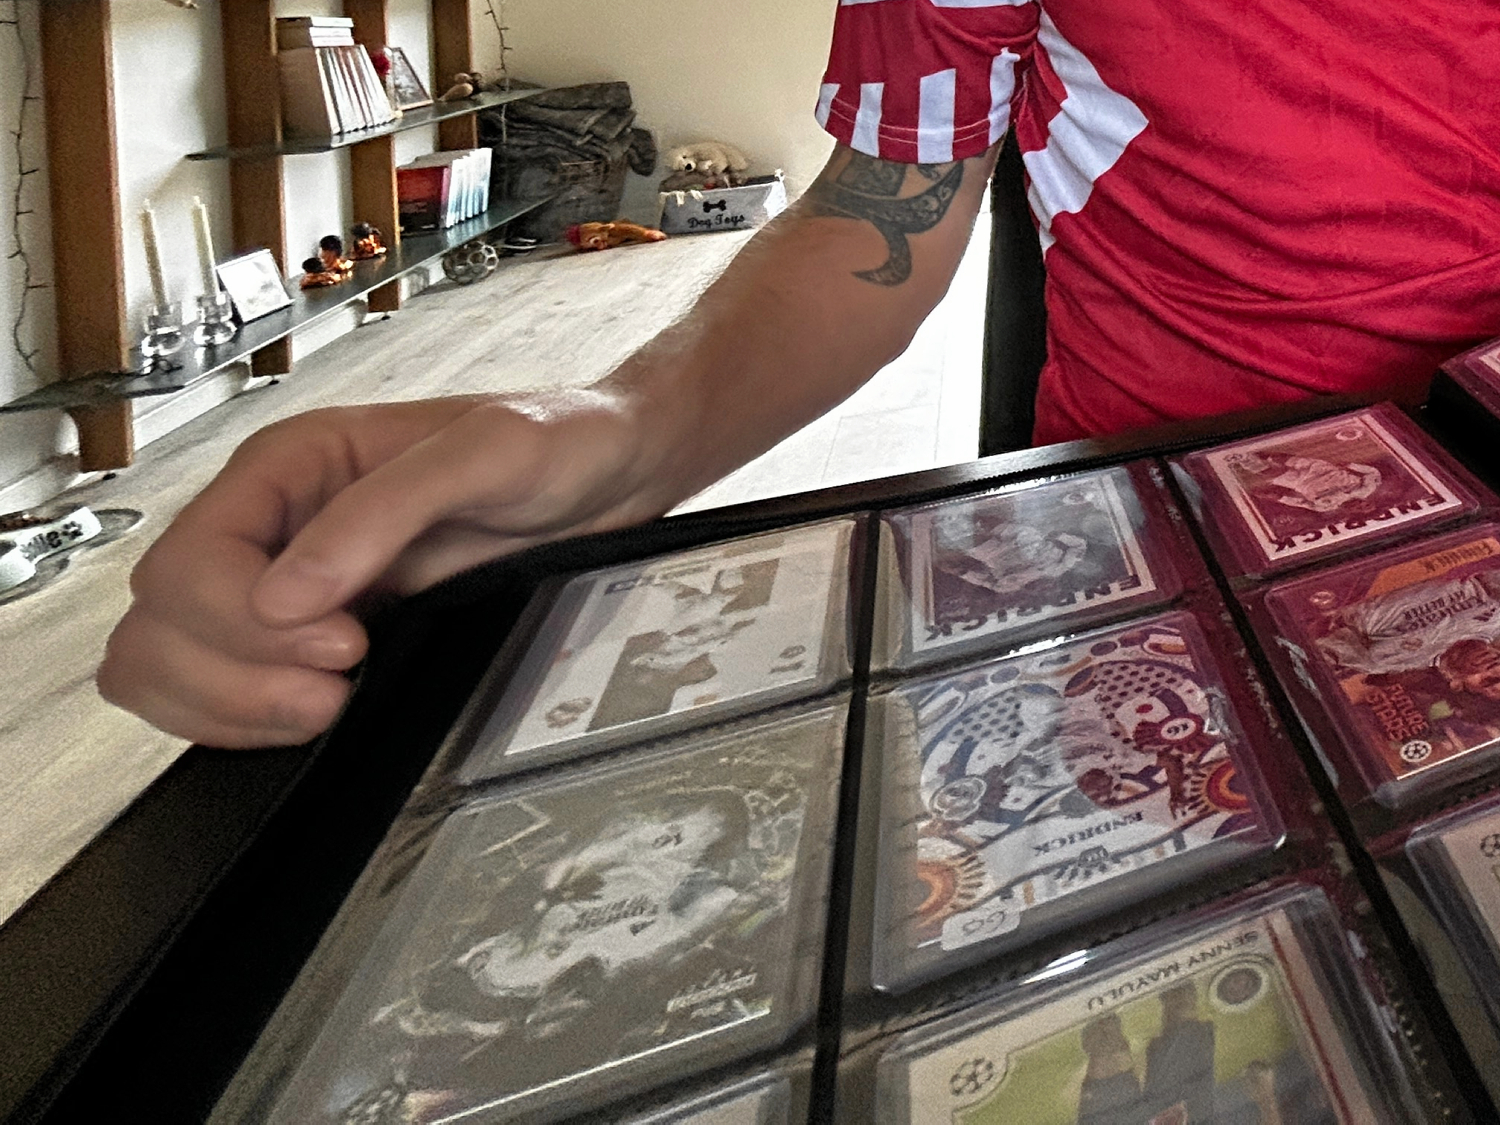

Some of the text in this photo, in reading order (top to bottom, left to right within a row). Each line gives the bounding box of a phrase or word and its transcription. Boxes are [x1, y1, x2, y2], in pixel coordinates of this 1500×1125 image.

[688, 214, 745, 229] Dog Toys
[1034, 812, 1142, 857] ENDRICK
[1087, 957, 1182, 1012] MAYULU
